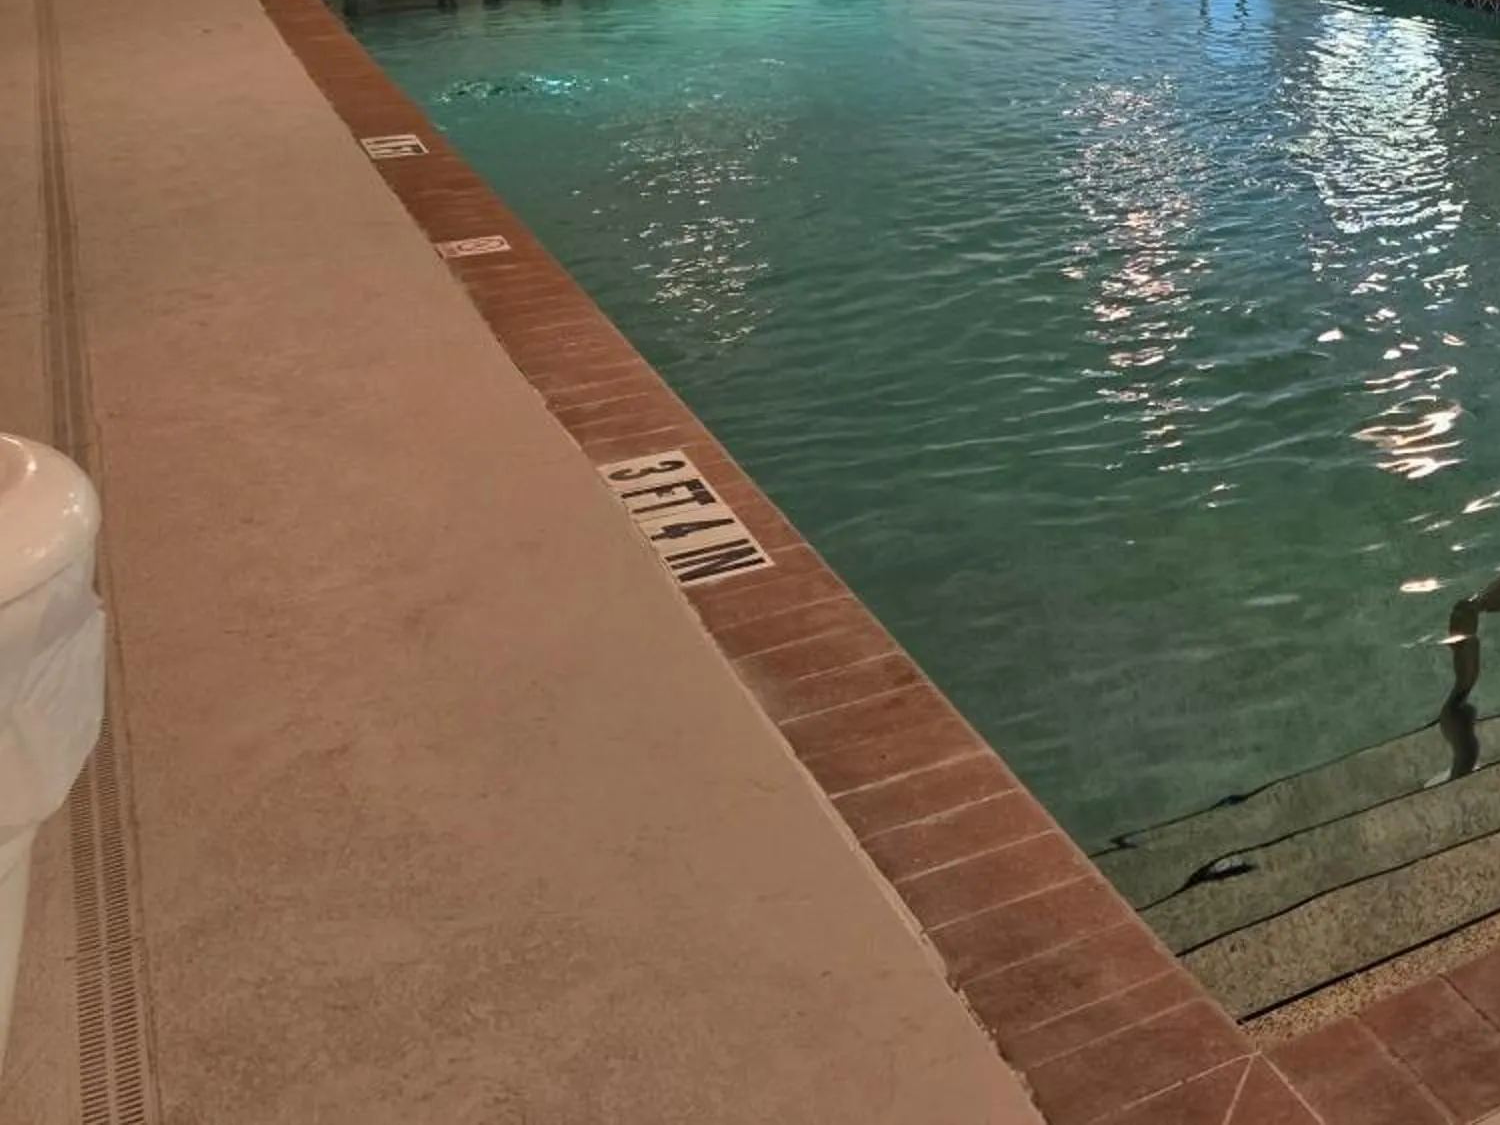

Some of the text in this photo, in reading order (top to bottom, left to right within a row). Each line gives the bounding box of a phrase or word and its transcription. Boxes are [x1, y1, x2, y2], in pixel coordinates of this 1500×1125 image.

[606, 460, 767, 583] 3 FT 4 IN
